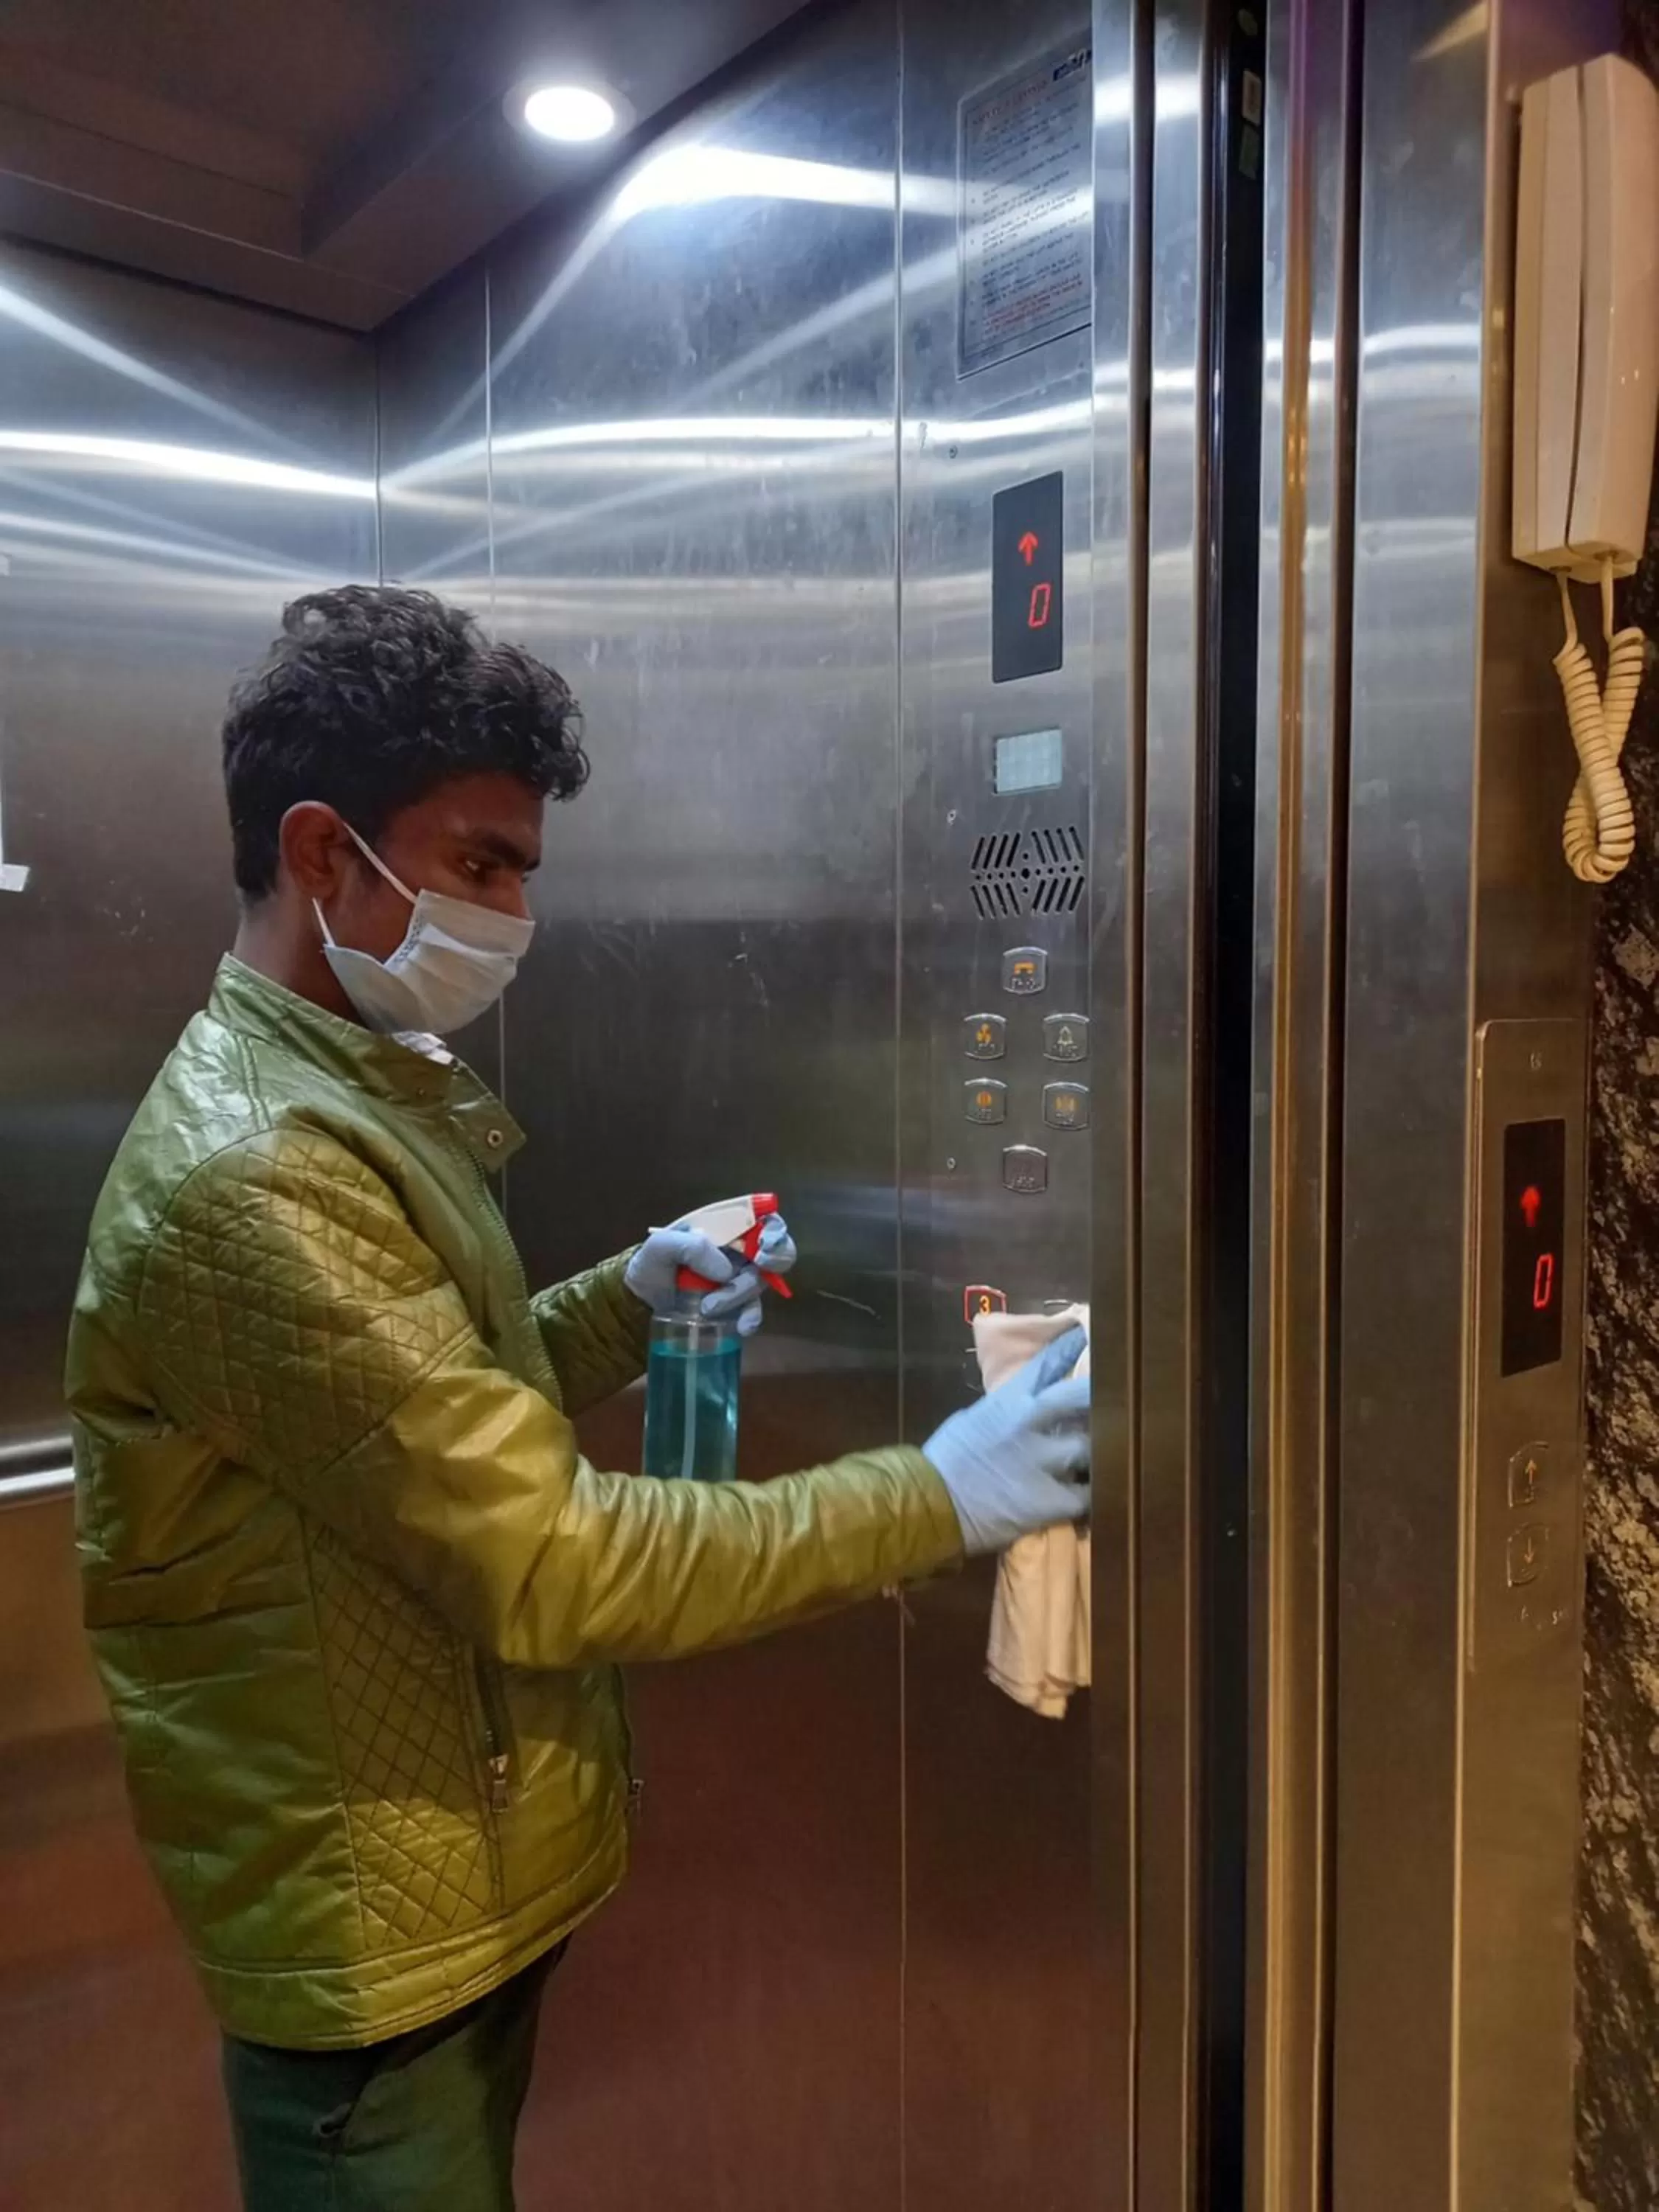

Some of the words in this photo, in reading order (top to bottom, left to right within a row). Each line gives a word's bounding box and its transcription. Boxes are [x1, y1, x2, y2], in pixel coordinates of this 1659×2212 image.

[1029, 582, 1051, 627] 0
[1534, 1253, 1553, 1309] 0
[978, 1294, 991, 1315] 3
